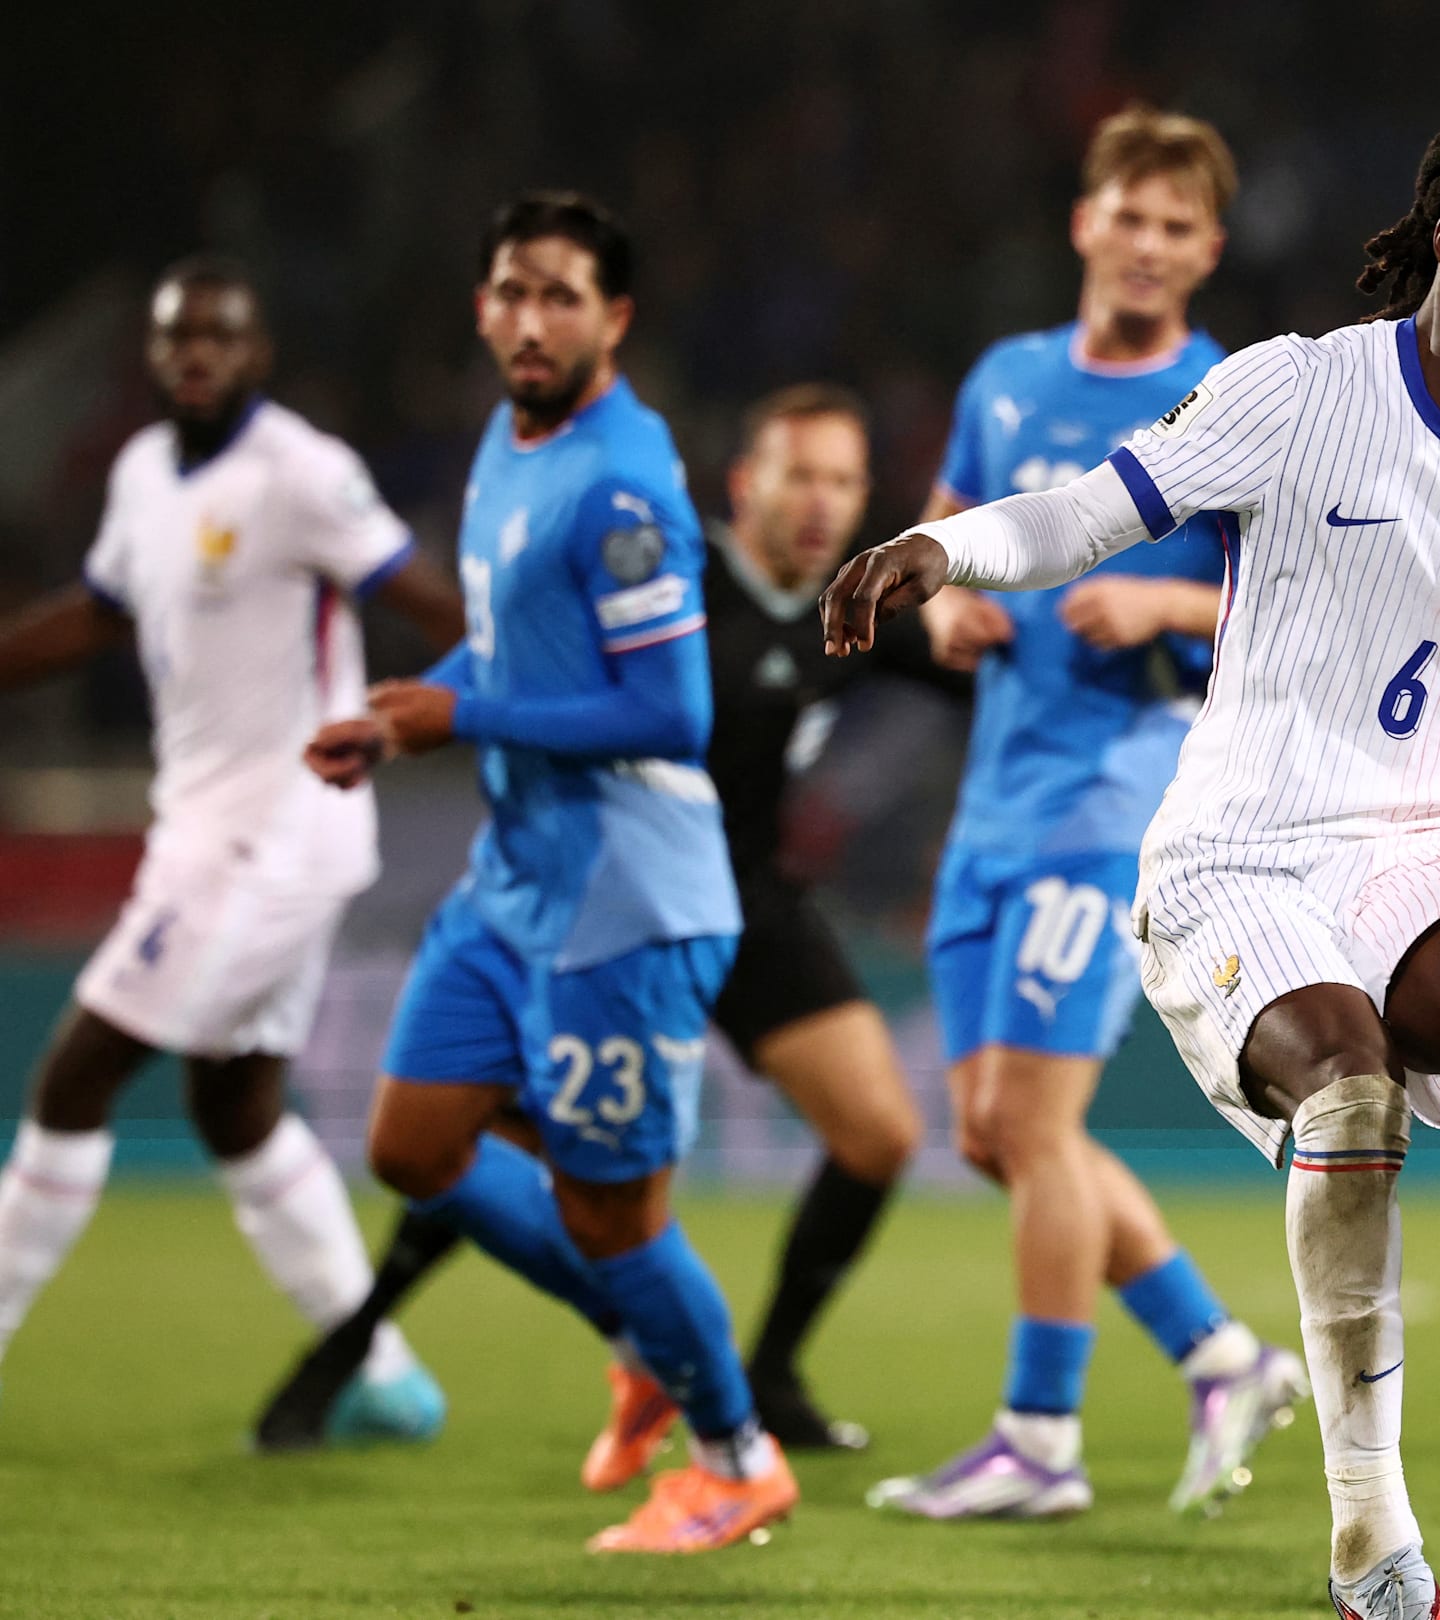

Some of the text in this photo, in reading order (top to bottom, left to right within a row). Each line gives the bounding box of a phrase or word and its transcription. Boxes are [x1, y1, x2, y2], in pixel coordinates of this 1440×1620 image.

[1378, 639, 1439, 741] 6
[1016, 875, 1109, 984] 10
[546, 1032, 647, 1126] 23
